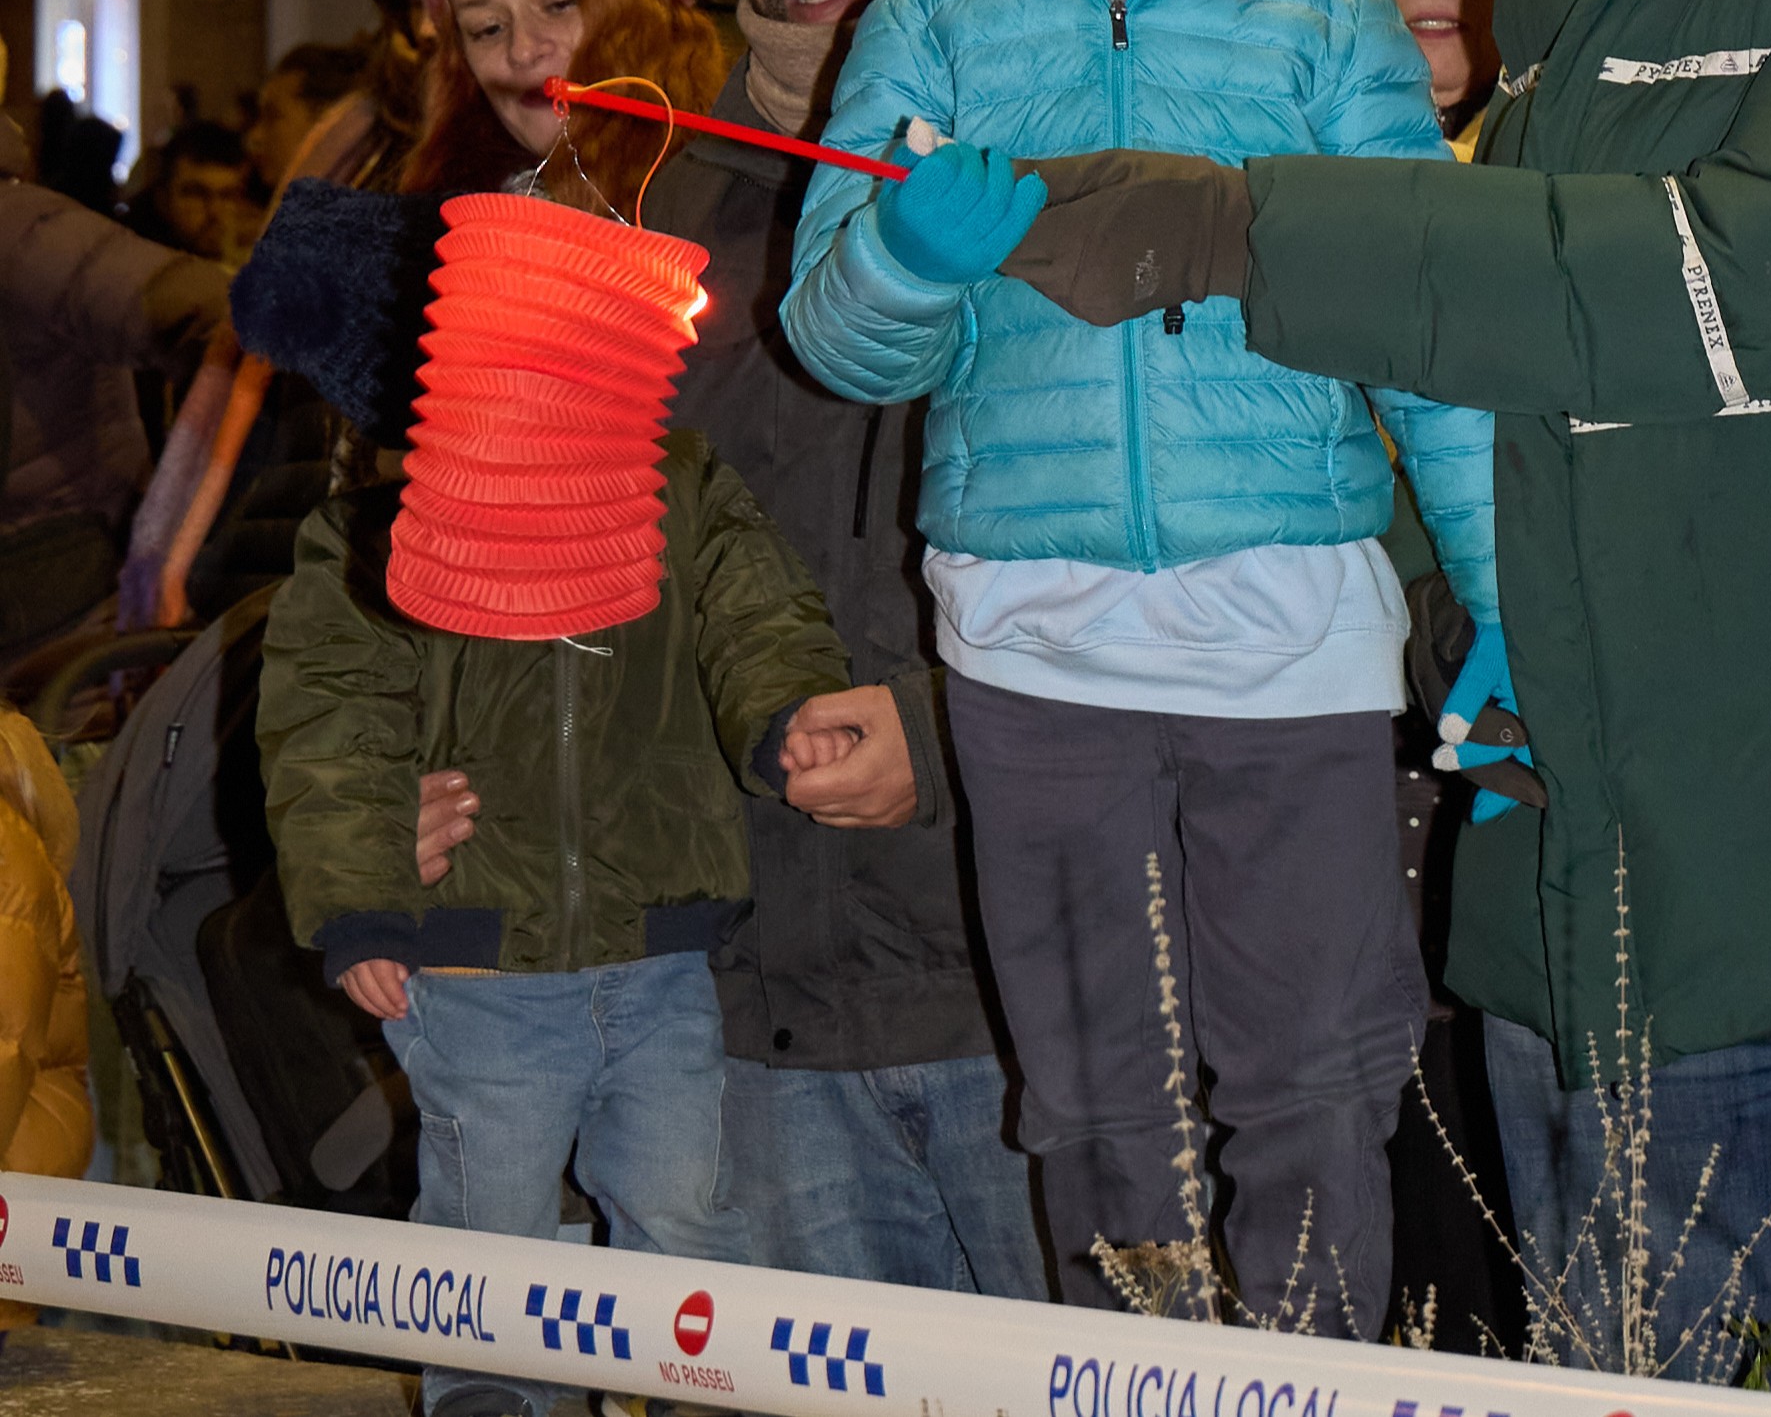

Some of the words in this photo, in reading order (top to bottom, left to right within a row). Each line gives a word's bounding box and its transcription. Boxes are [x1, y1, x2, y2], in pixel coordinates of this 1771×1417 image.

[1687, 264, 1725, 350] PYRENEX
[266, 1246, 386, 1328] POLICIA
[393, 1264, 496, 1344] LOCAL
[659, 1361, 681, 1384] NO
[681, 1364, 735, 1393] PASSEU
